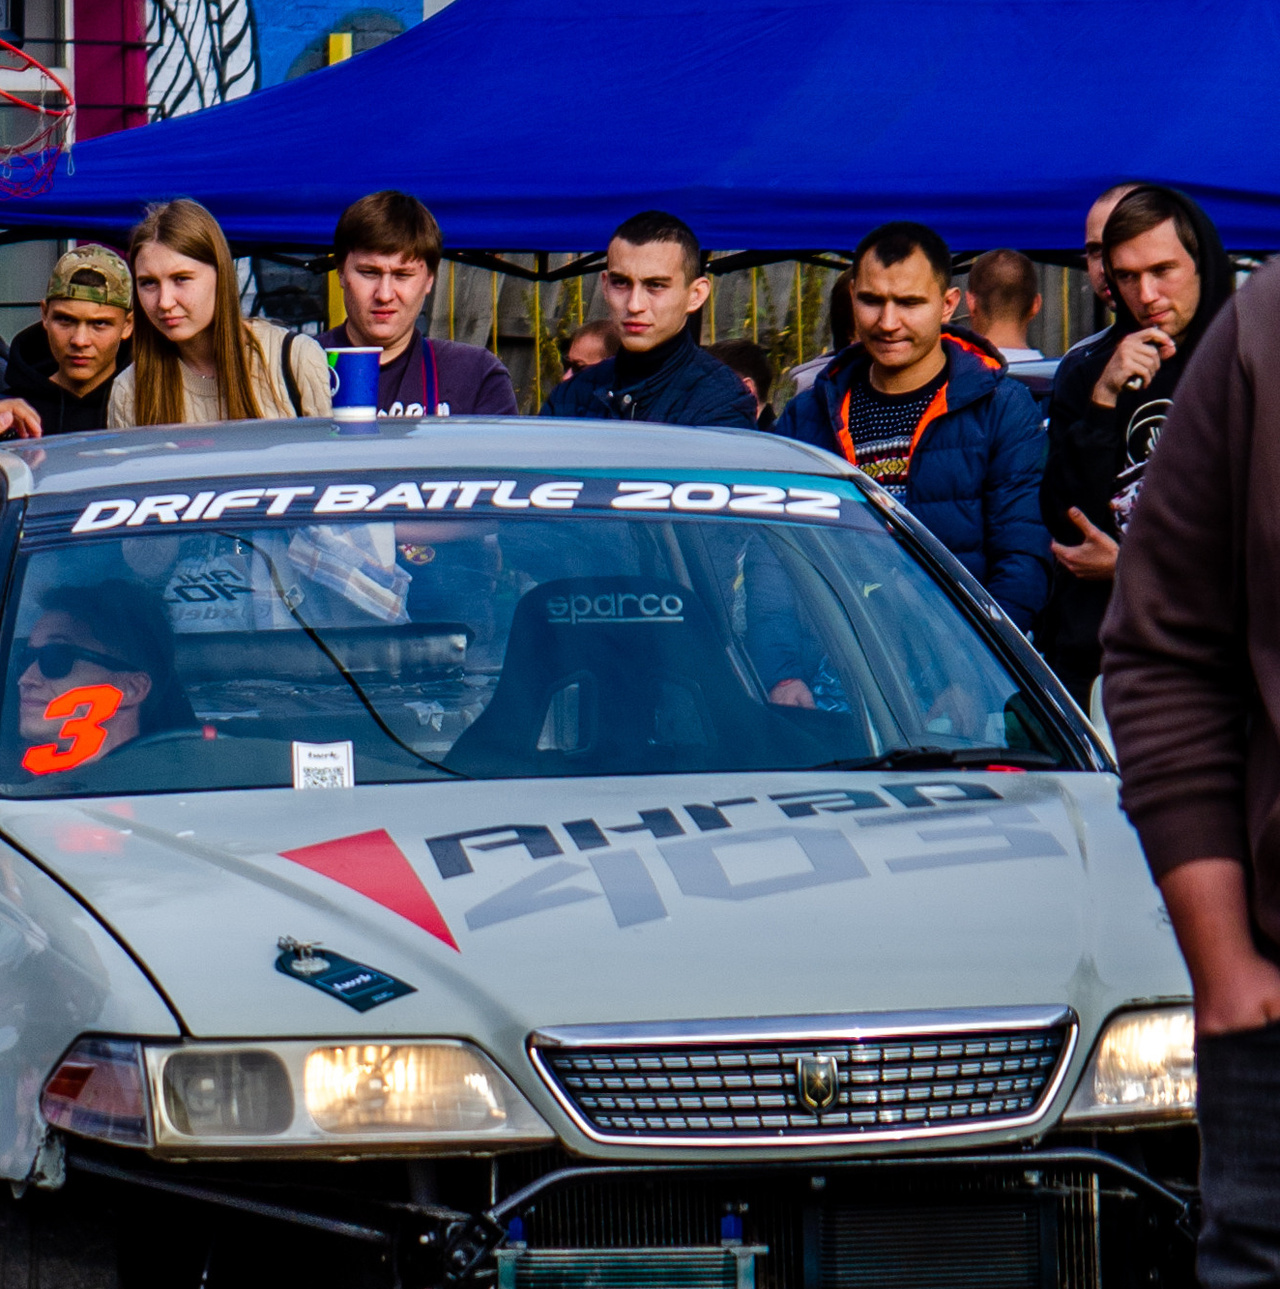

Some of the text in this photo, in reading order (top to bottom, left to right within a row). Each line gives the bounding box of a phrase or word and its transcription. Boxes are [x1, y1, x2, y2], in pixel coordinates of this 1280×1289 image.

[70, 480, 842, 533] DRIFT BATTLE 2022
[547, 591, 684, 624] sparco
[22, 683, 124, 775] 3
